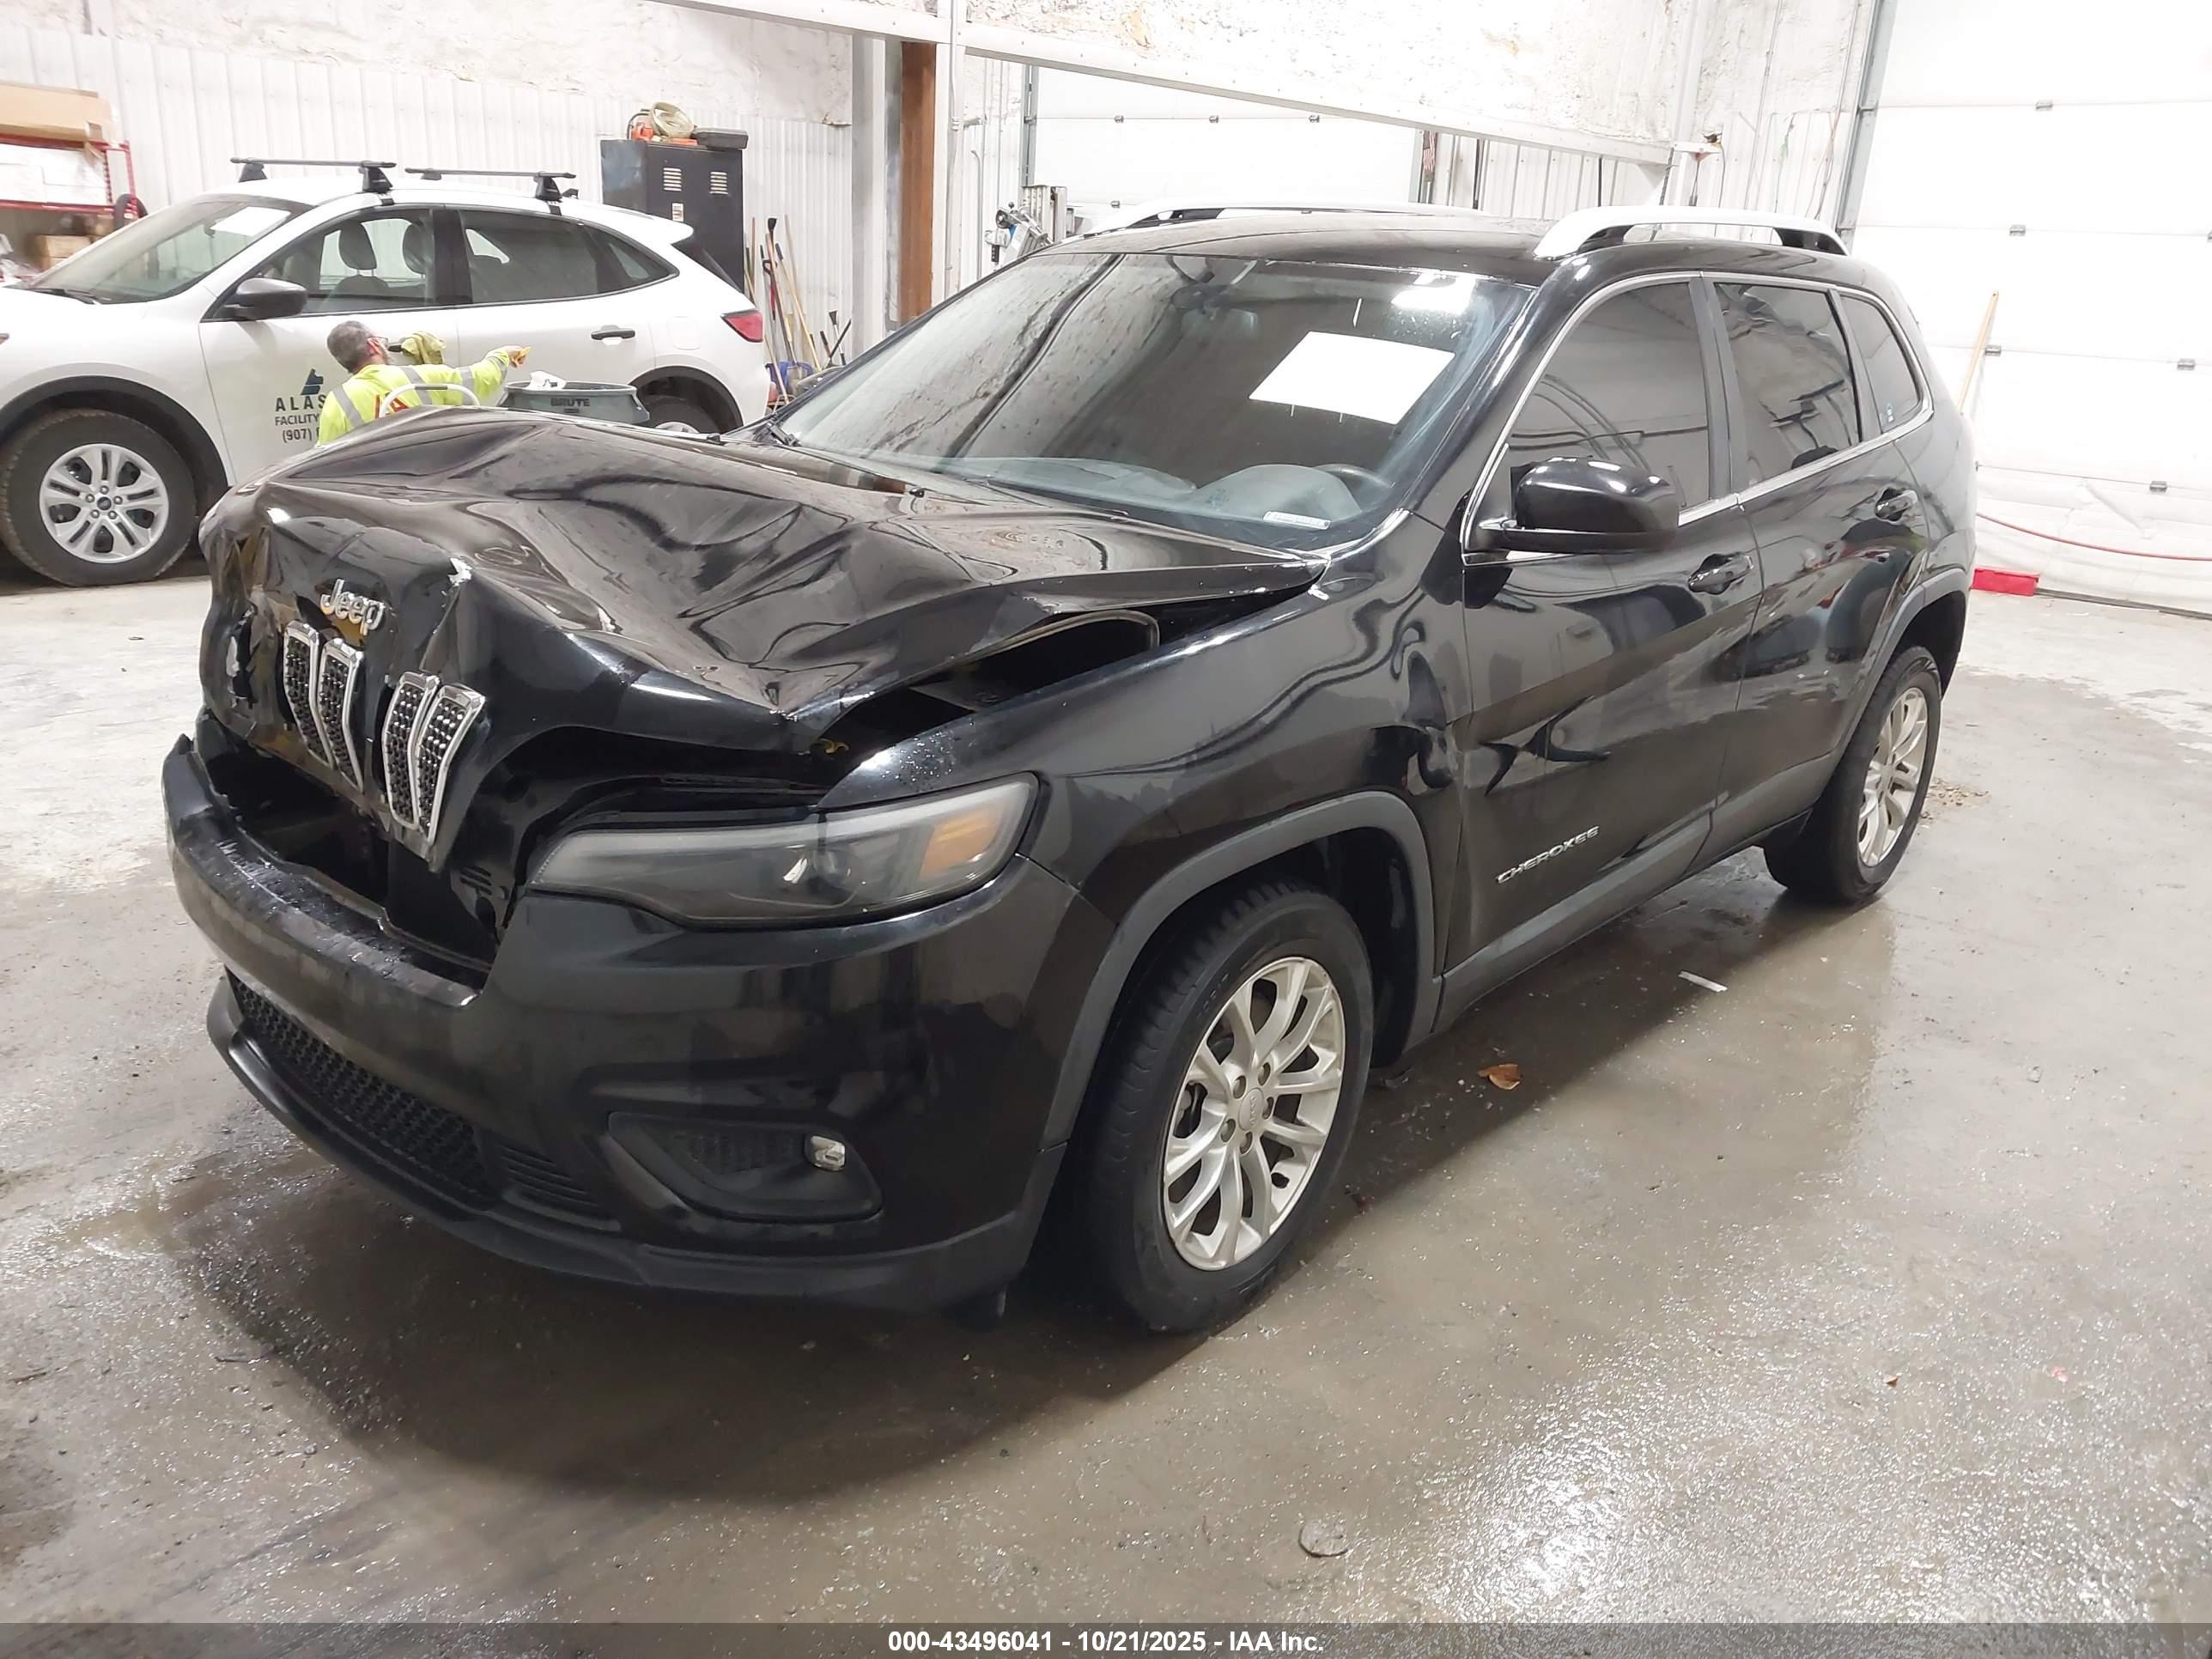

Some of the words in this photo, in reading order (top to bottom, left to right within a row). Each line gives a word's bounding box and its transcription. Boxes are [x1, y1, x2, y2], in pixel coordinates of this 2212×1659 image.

[550, 398, 590, 407] BRUTE
[275, 413, 319, 426] FACILITY
[283, 428, 313, 444] (907)
[320, 578, 386, 636] Jeep
[1497, 825, 1600, 884] CHEROKEE
